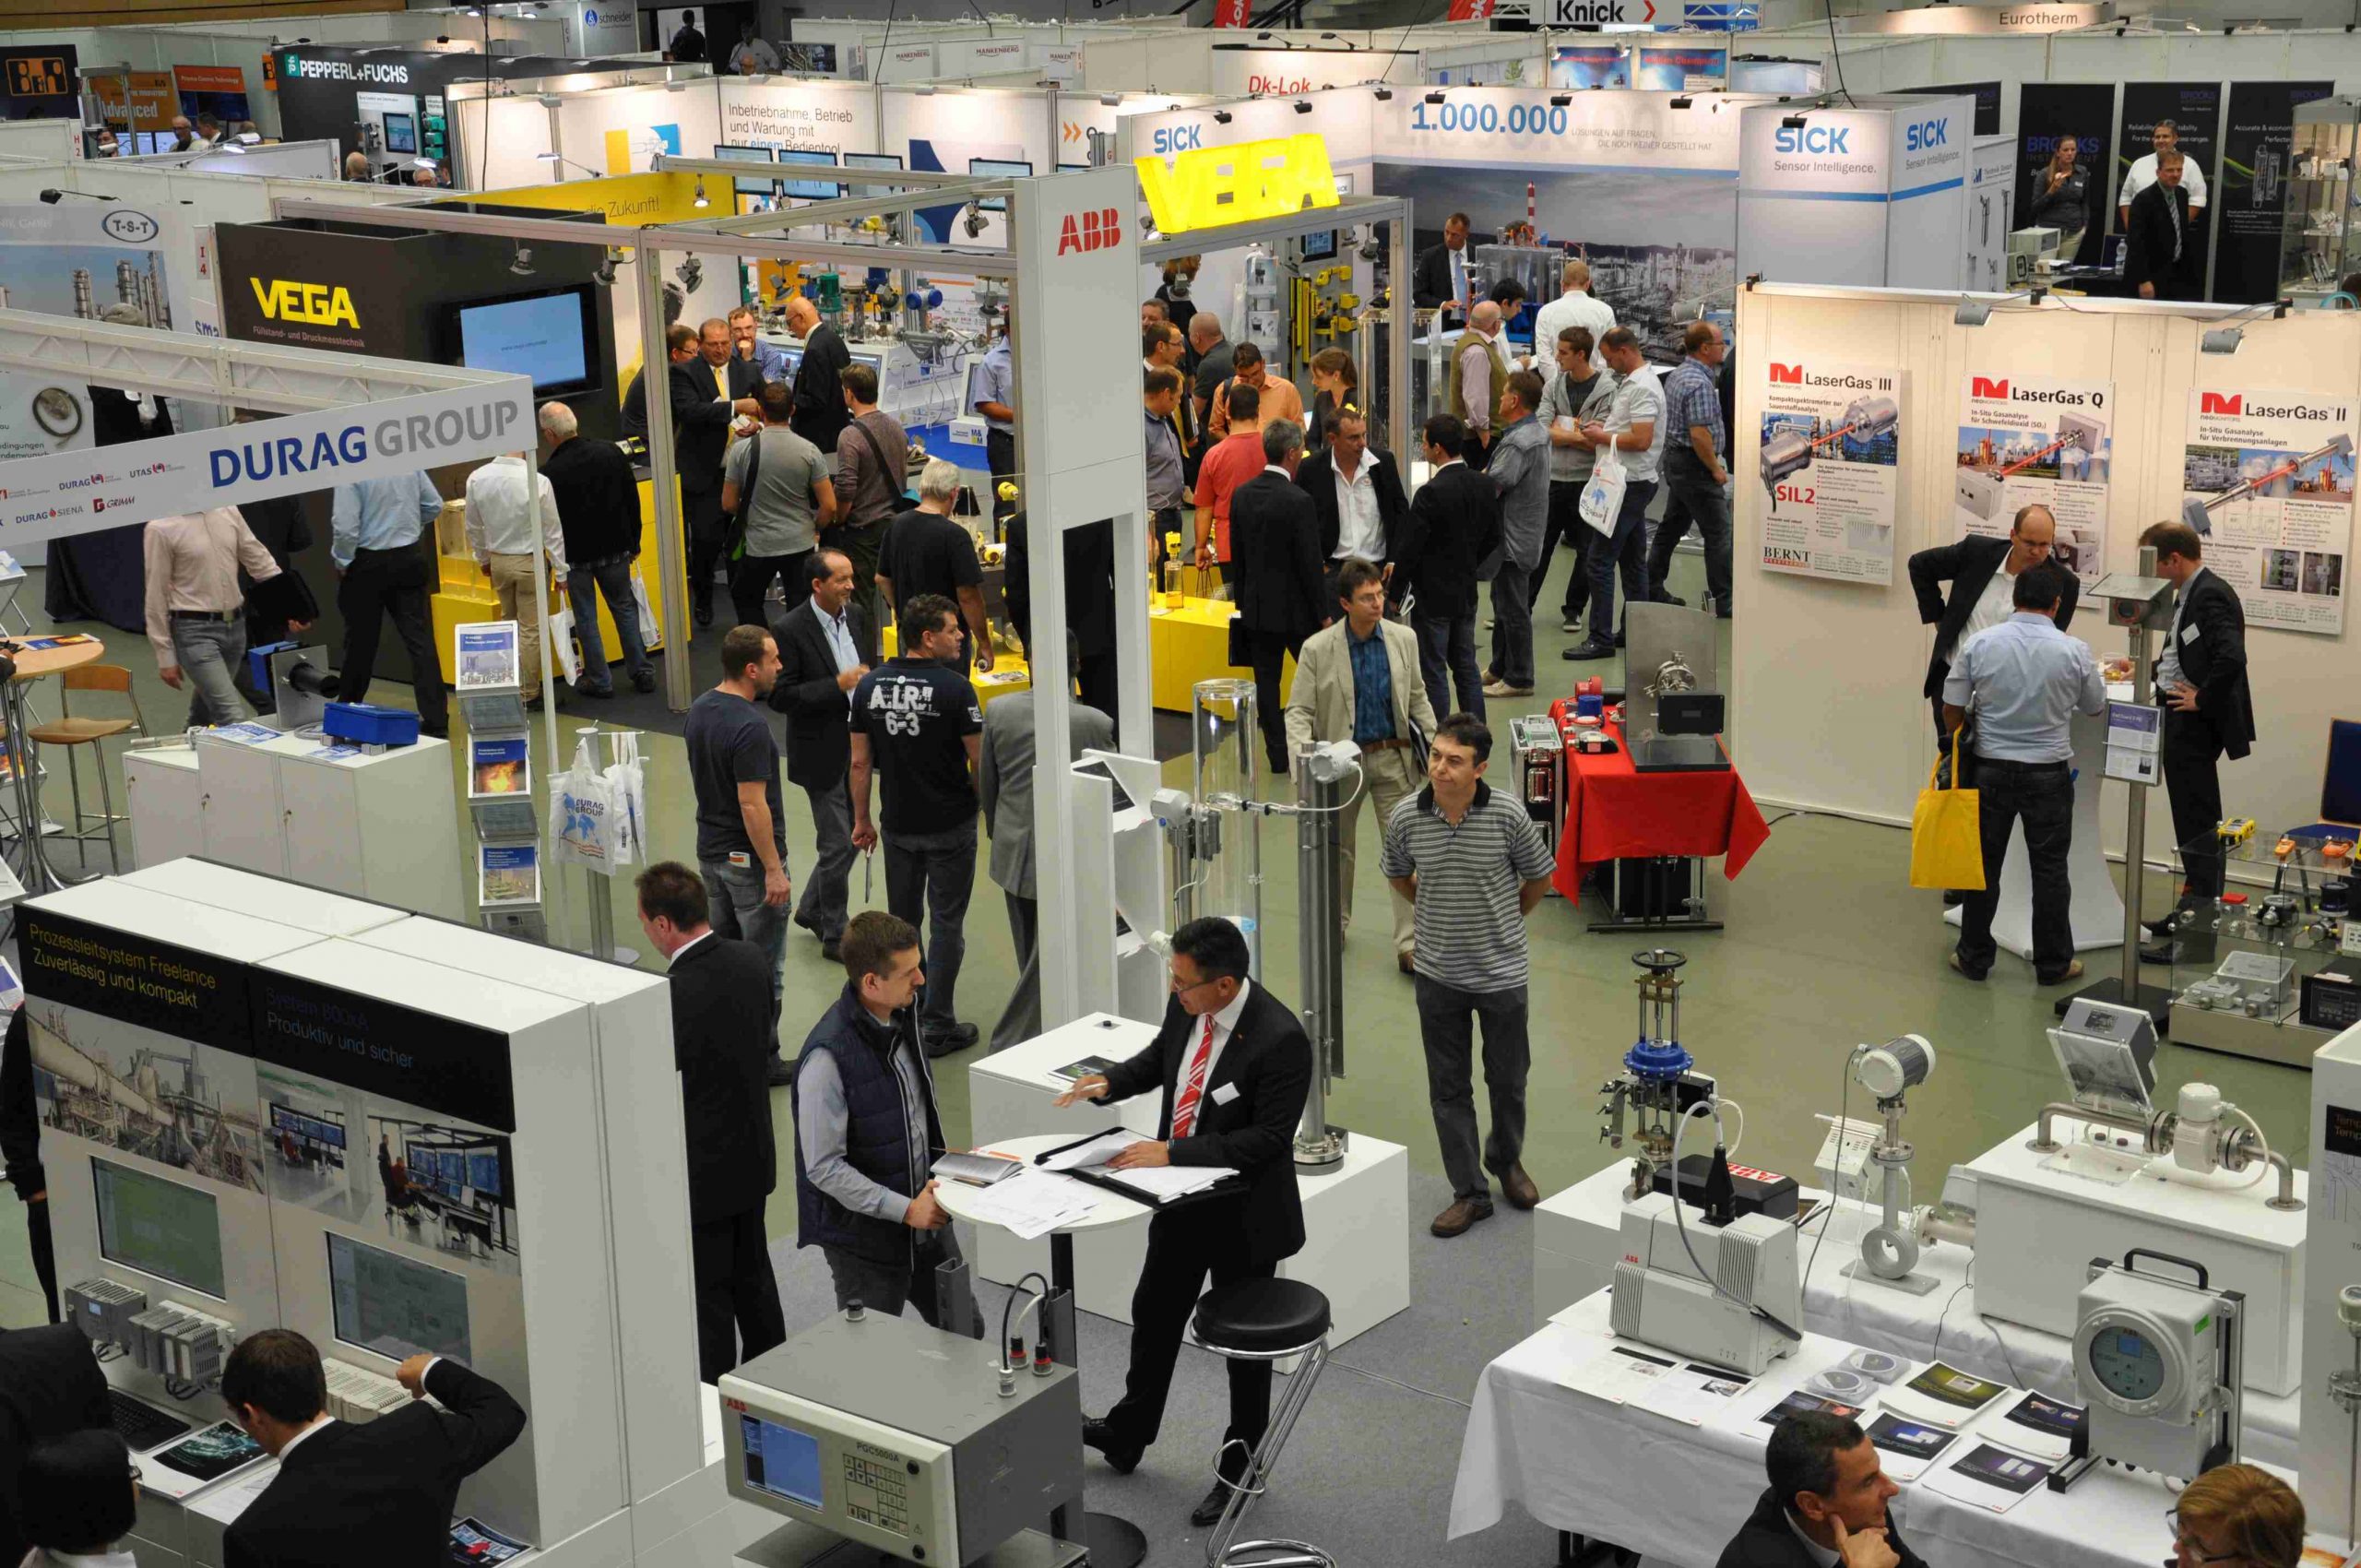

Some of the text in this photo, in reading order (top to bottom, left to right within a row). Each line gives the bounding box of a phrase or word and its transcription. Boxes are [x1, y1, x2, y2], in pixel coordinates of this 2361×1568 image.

[599, 10, 632, 23] schneider
[1557, 0, 1624, 22] Knick
[1999, 12, 2078, 25] Eurotherm
[896, 51, 931, 60] MANKENBERG
[976, 46, 1020, 55] MANKENBERG
[300, 60, 409, 84] PEPPERL+FUCHS
[1249, 76, 1311, 93] Dk-Lok
[729, 103, 853, 123] Inbetriebnahme, Betrieb
[1411, 101, 1567, 136] 1.000.000
[730, 122, 814, 139] und Wartung mit
[1907, 117, 1949, 152] SICK
[1154, 124, 1202, 154] SICK
[1775, 126, 1849, 154] SICK
[1774, 160, 1877, 174] Sensor Intelligence.
[1905, 156, 1927, 171] Sensor
[1133, 133, 1340, 234] VEGA
[608, 196, 660, 218] Zukunft!
[113, 220, 148, 233] T-S-T
[1057, 208, 1121, 255] ABB
[200, 264, 207, 275] 4
[250, 277, 361, 329] VEGA
[253, 326, 365, 348] Füllstand- und Druckmesstechnik
[1879, 378, 1892, 390] III
[2092, 392, 2104, 409] Q
[1982, 418, 2029, 427] Schwefeldioxid
[1993, 410, 2028, 420] Gasanalyse
[2336, 408, 2346, 422] II
[2212, 434, 2288, 446] Verbrennungsanlagen
[2225, 427, 2264, 437] Gasanalyse
[209, 399, 518, 488] DURAG GROUP
[129, 468, 152, 479] UTAS
[58, 478, 90, 491] DURAG
[106, 496, 136, 508] GRIMM
[16, 505, 84, 524] DURAG SIENA
[1764, 547, 1811, 562] BERNT
[884, 710, 920, 736] 6-3
[575, 799, 604, 811] DURAG
[30, 922, 217, 990] Prozessleitsystem Freelance
[33, 947, 198, 1009] Zuverlässig und kompakt
[267, 1011, 414, 1069] Produktiv und sicher
[1625, 1253, 1639, 1264] ABB
[2123, 1328, 2139, 1336] ABB
[727, 1397, 747, 1413] ABB
[857, 1442, 900, 1463] PGC5000A
